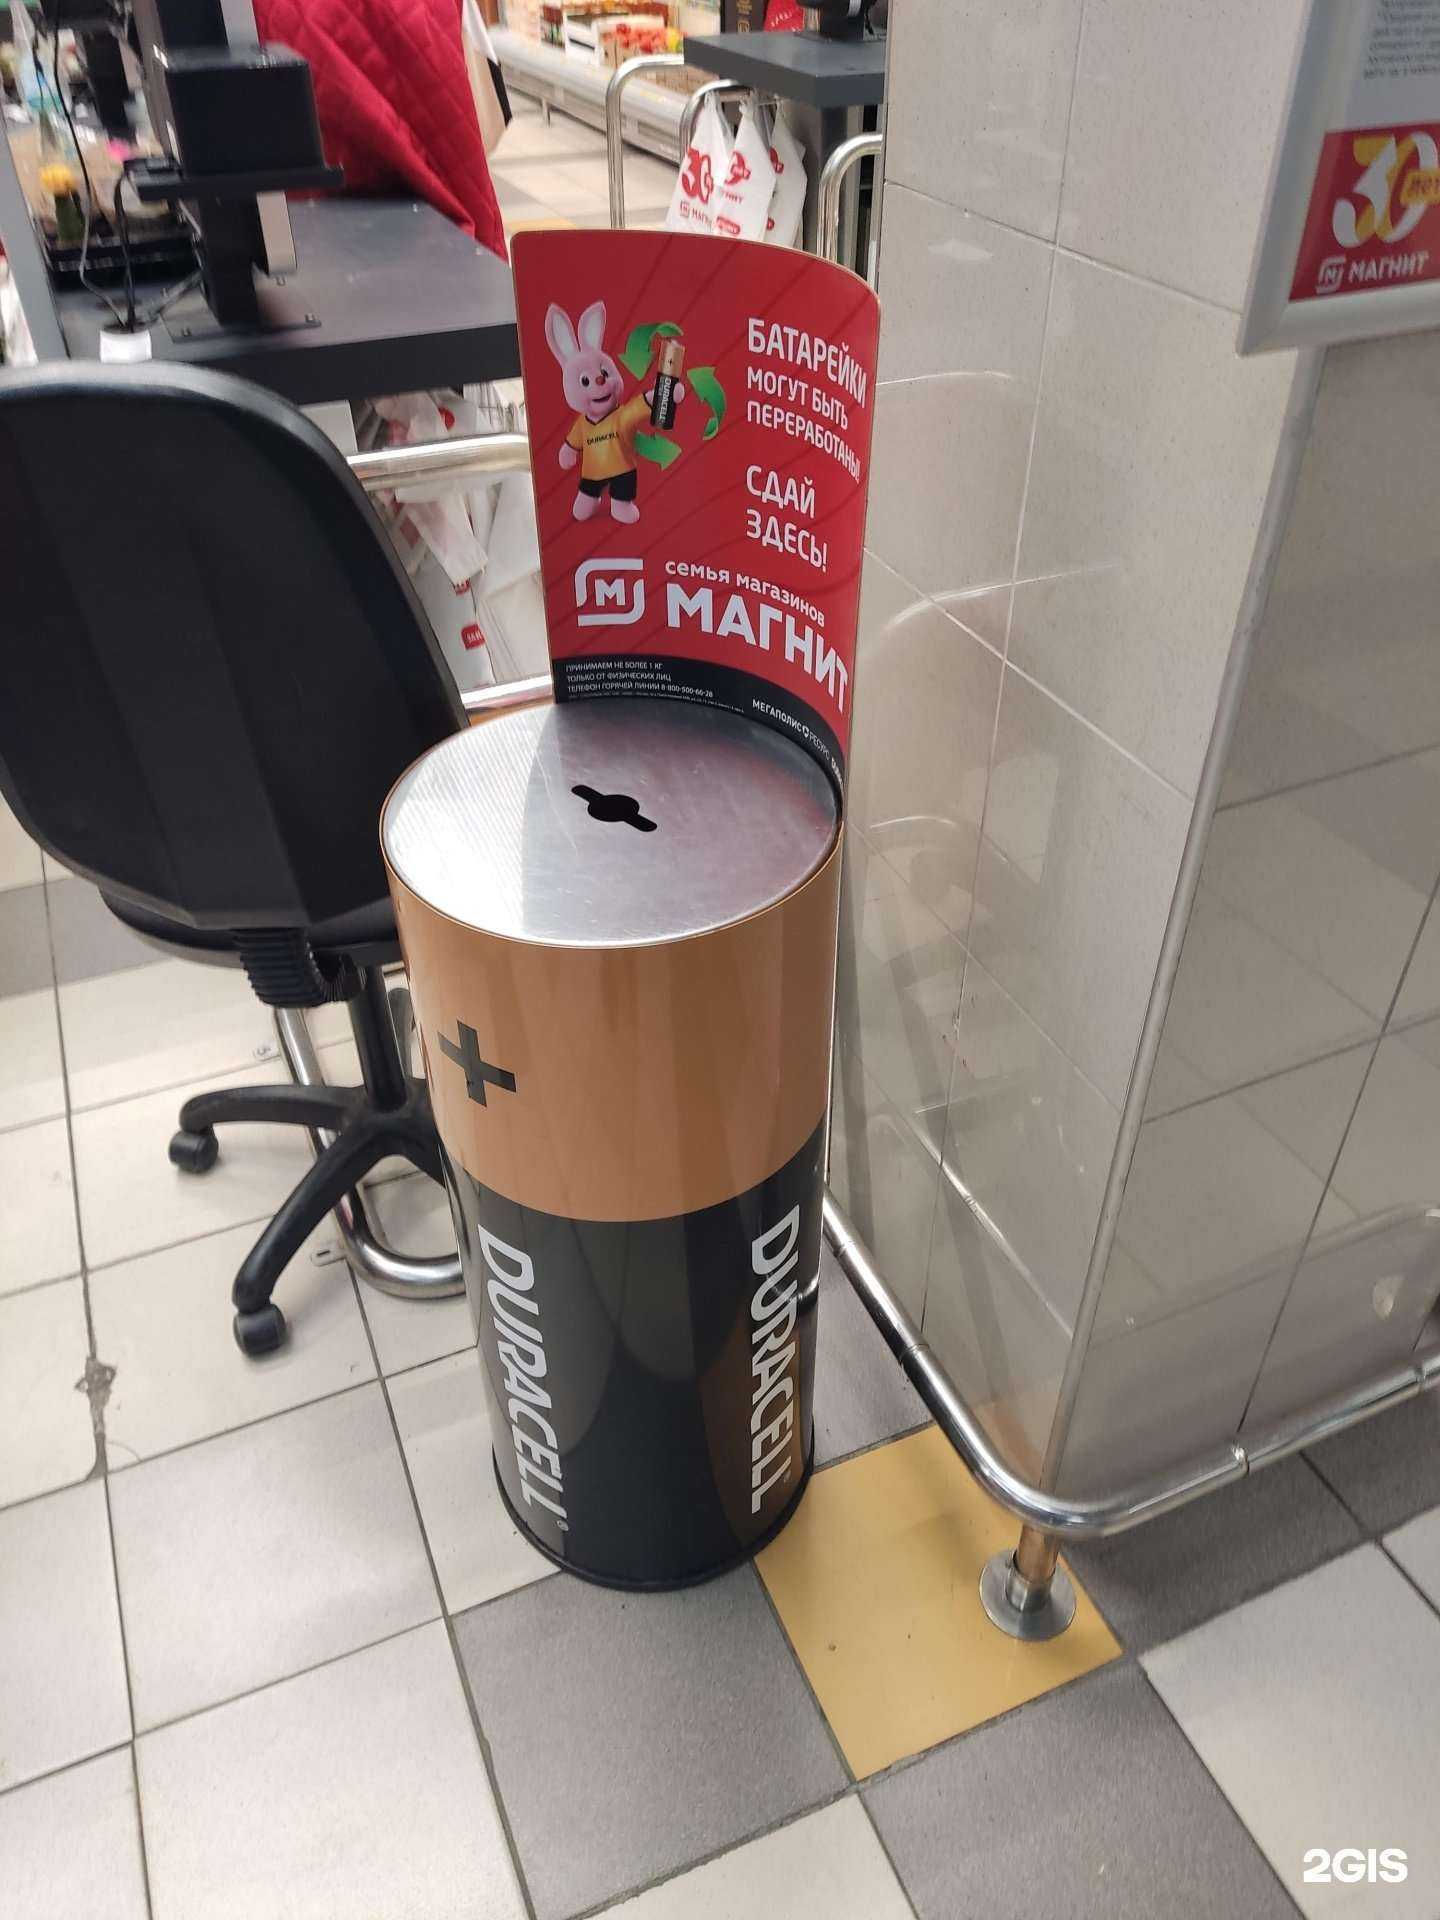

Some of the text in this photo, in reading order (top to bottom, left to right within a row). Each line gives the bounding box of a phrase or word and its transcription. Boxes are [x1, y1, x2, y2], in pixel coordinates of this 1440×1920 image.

[1348, 250, 1429, 284] МАГНИТ
[748, 317, 867, 409] БАТАРЕЙКИ
[747, 366, 848, 430] МОГУТ БЫТЬ
[746, 464, 815, 519] СДАЙ
[746, 508, 828, 573] ЗДЕСЬ!
[665, 559, 825, 628] семья магазинов
[566, 662, 612, 672] ПРИНИМАЕМ
[625, 661, 647, 669] БОЛЕЕ
[655, 662, 664, 670] КГ
[567, 672, 672, 683] ТОЛЬКО ОТ ФИЗИЧЕСКИХ ЛИЦ
[666, 582, 848, 714] МАГНИТ
[568, 682, 600, 693] ТЕЛЕФОН
[602, 681, 633, 690] ГОРЯЧЕЙ
[635, 682, 660, 691] ЛИНИИ
[752, 699, 802, 733] МЕГАПОЛИС
[477, 1223, 568, 1520] DURACELL
[750, 1204, 800, 1514] DURACELL
